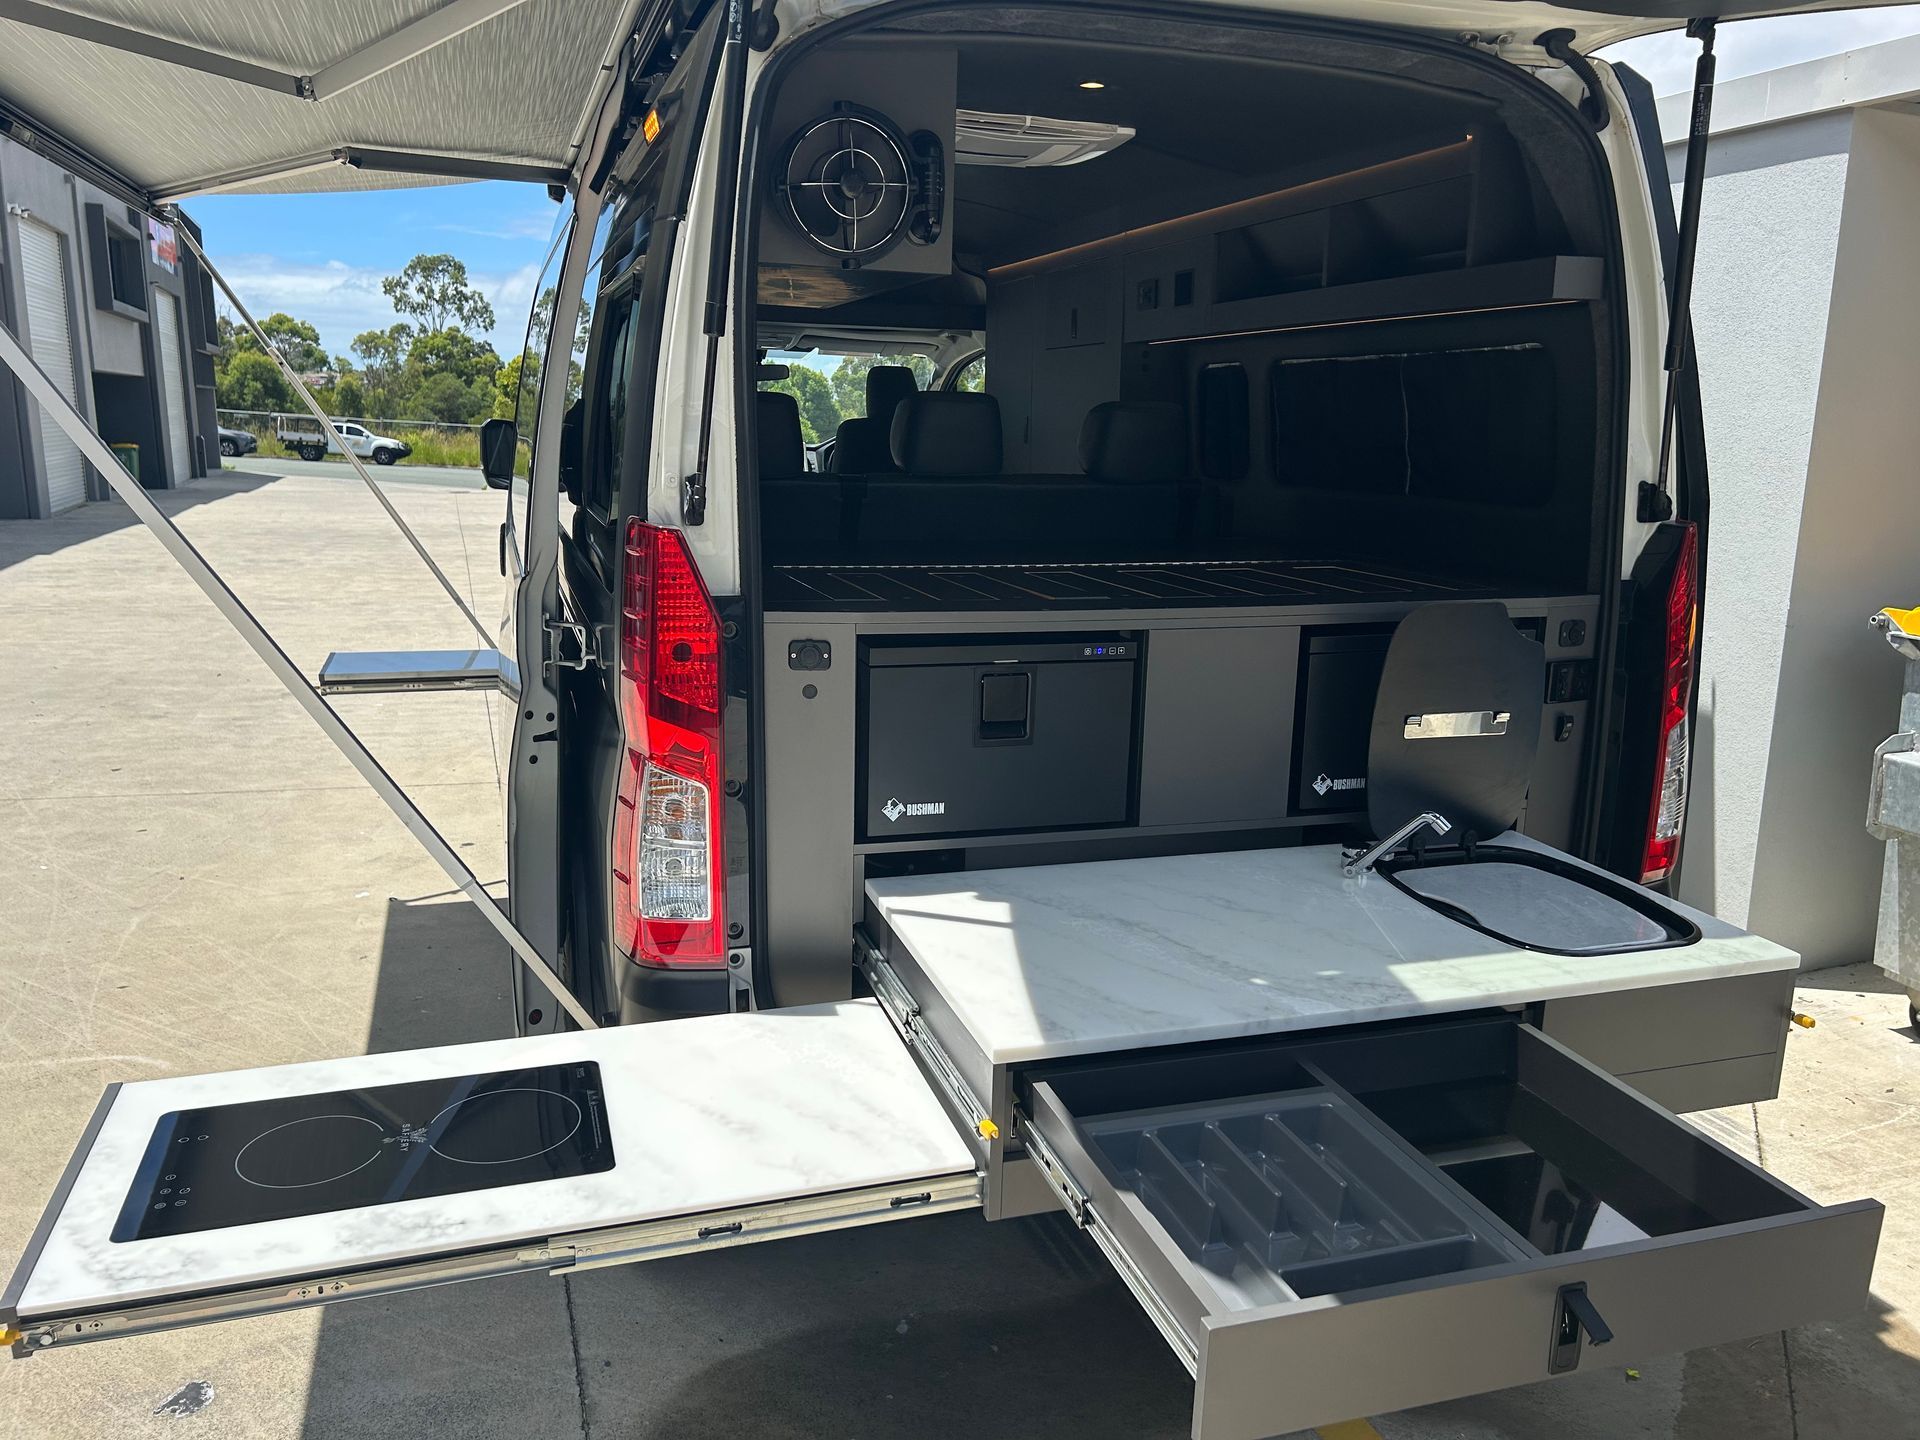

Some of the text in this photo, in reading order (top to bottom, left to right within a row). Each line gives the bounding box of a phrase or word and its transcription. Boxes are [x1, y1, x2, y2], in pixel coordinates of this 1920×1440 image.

[1333, 777, 1366, 790] BUSHMAN
[906, 802, 945, 816] BUSHMAN
[400, 1123, 411, 1152] SAFIERY
